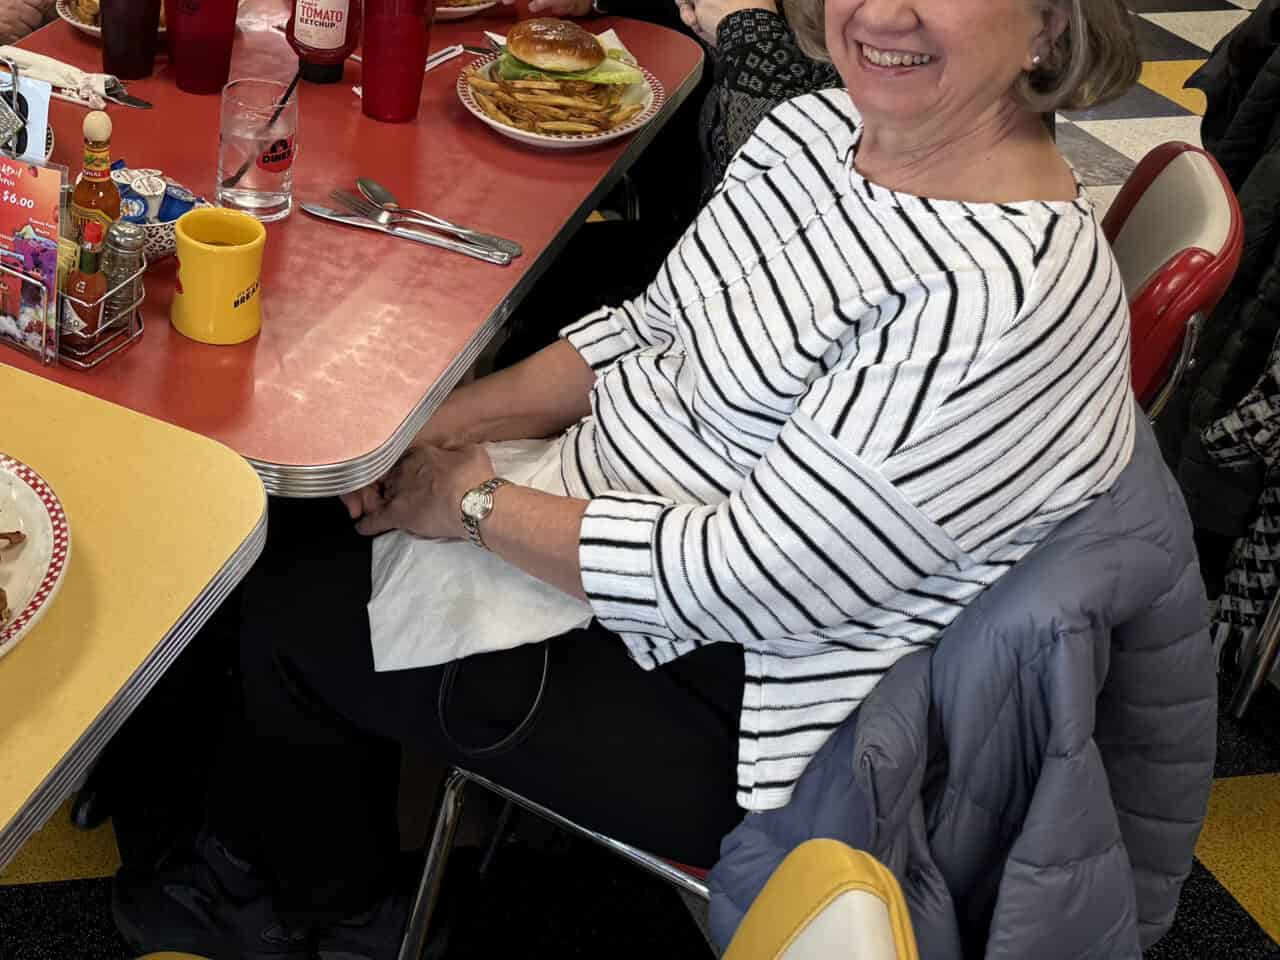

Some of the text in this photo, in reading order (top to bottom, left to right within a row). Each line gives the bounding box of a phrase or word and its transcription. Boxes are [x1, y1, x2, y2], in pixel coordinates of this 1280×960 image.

[301, 6, 343, 22] TOMATO
[300, 17, 336, 29] KETCHUP
[3, 189, 34, 209] $6.00
